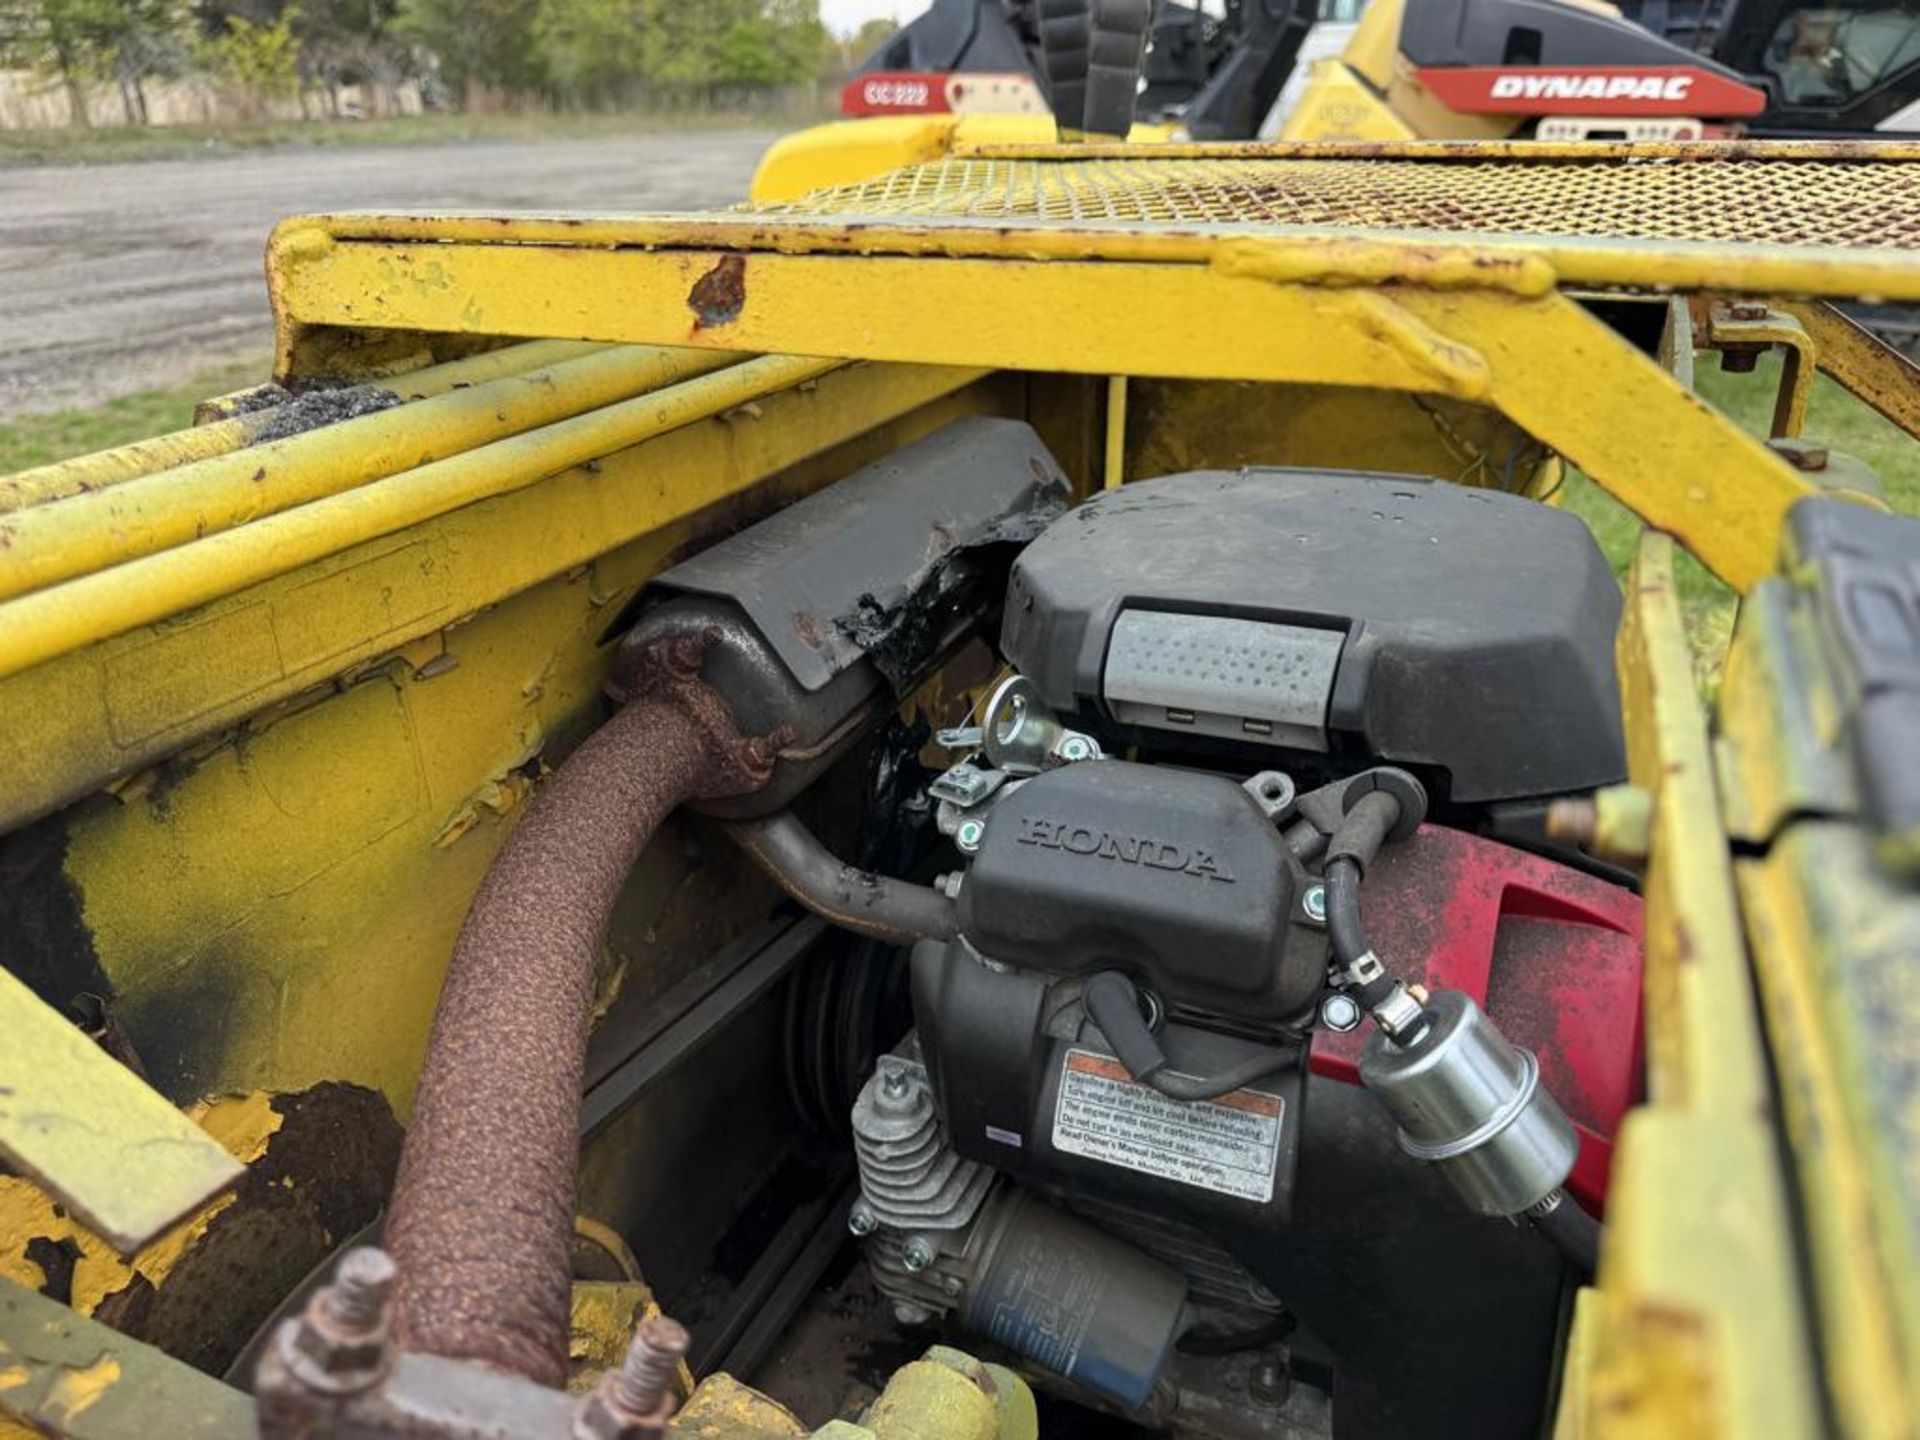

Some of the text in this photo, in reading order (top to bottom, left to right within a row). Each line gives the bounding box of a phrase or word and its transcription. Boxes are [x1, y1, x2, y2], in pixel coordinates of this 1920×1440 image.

[1491, 75, 1693, 99] DYNAPAC
[1017, 818, 1237, 884] HONDA
[1064, 1100, 1080, 1112] The
[1081, 1104, 1110, 1121] engine
[1067, 1084, 1086, 1097] Turn
[1133, 1100, 1150, 1113] and
[1059, 1126, 1082, 1140] Read
[1082, 1132, 1116, 1149] Owner's
[1117, 1140, 1148, 1157] Manual
[1150, 1149, 1178, 1164] before
[1062, 1113, 1074, 1124] Do
[1075, 1116, 1090, 1128] not
[1133, 1130, 1173, 1148] enclosed
